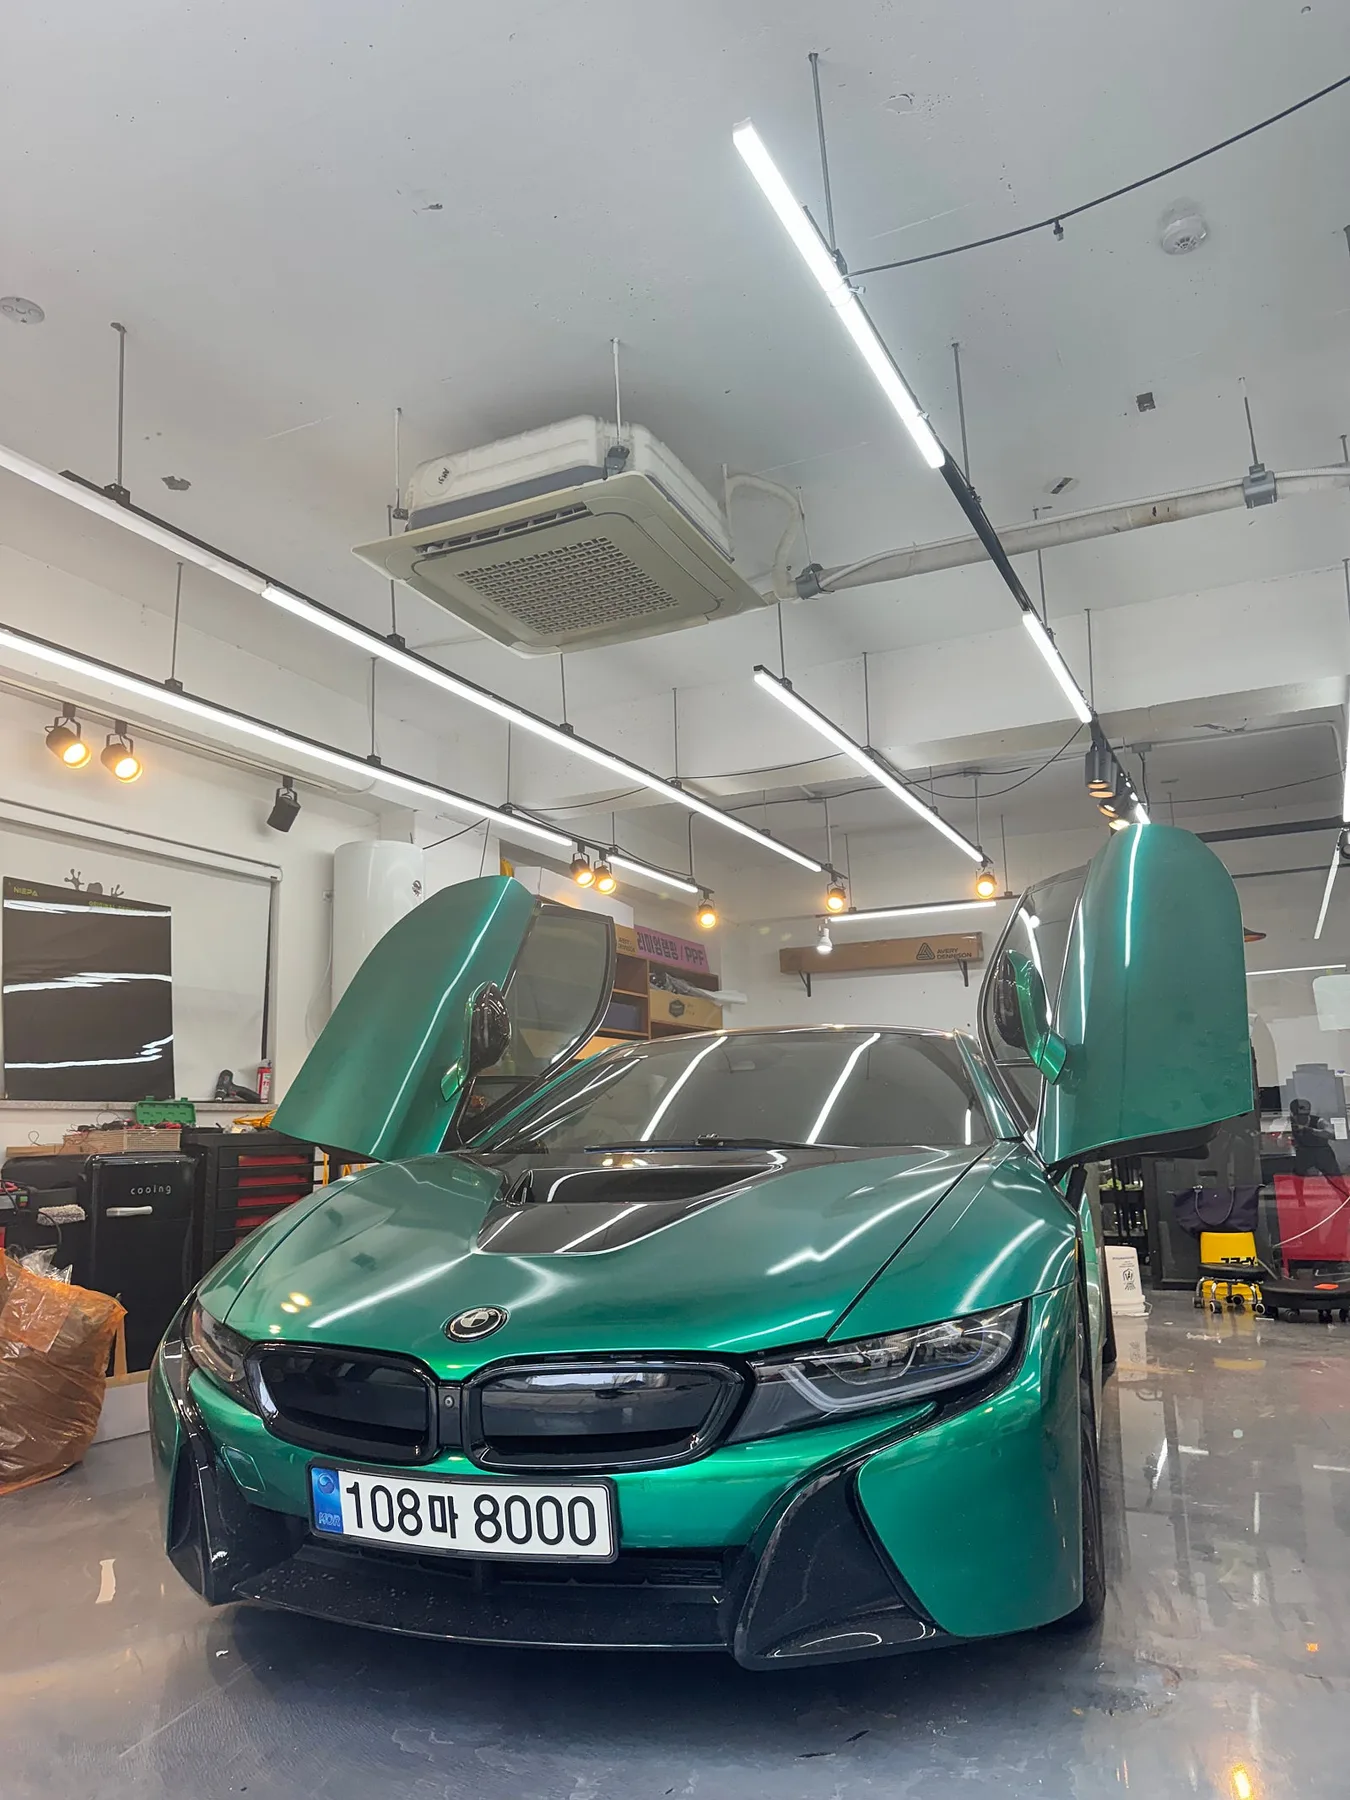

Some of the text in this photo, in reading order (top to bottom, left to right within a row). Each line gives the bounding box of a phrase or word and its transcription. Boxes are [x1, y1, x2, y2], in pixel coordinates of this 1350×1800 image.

[13, 886, 40, 897] NIEPA
[684, 945, 704, 966] PPF
[318, 1511, 341, 1527] KOR
[346, 1481, 597, 1546] 108마 8000
